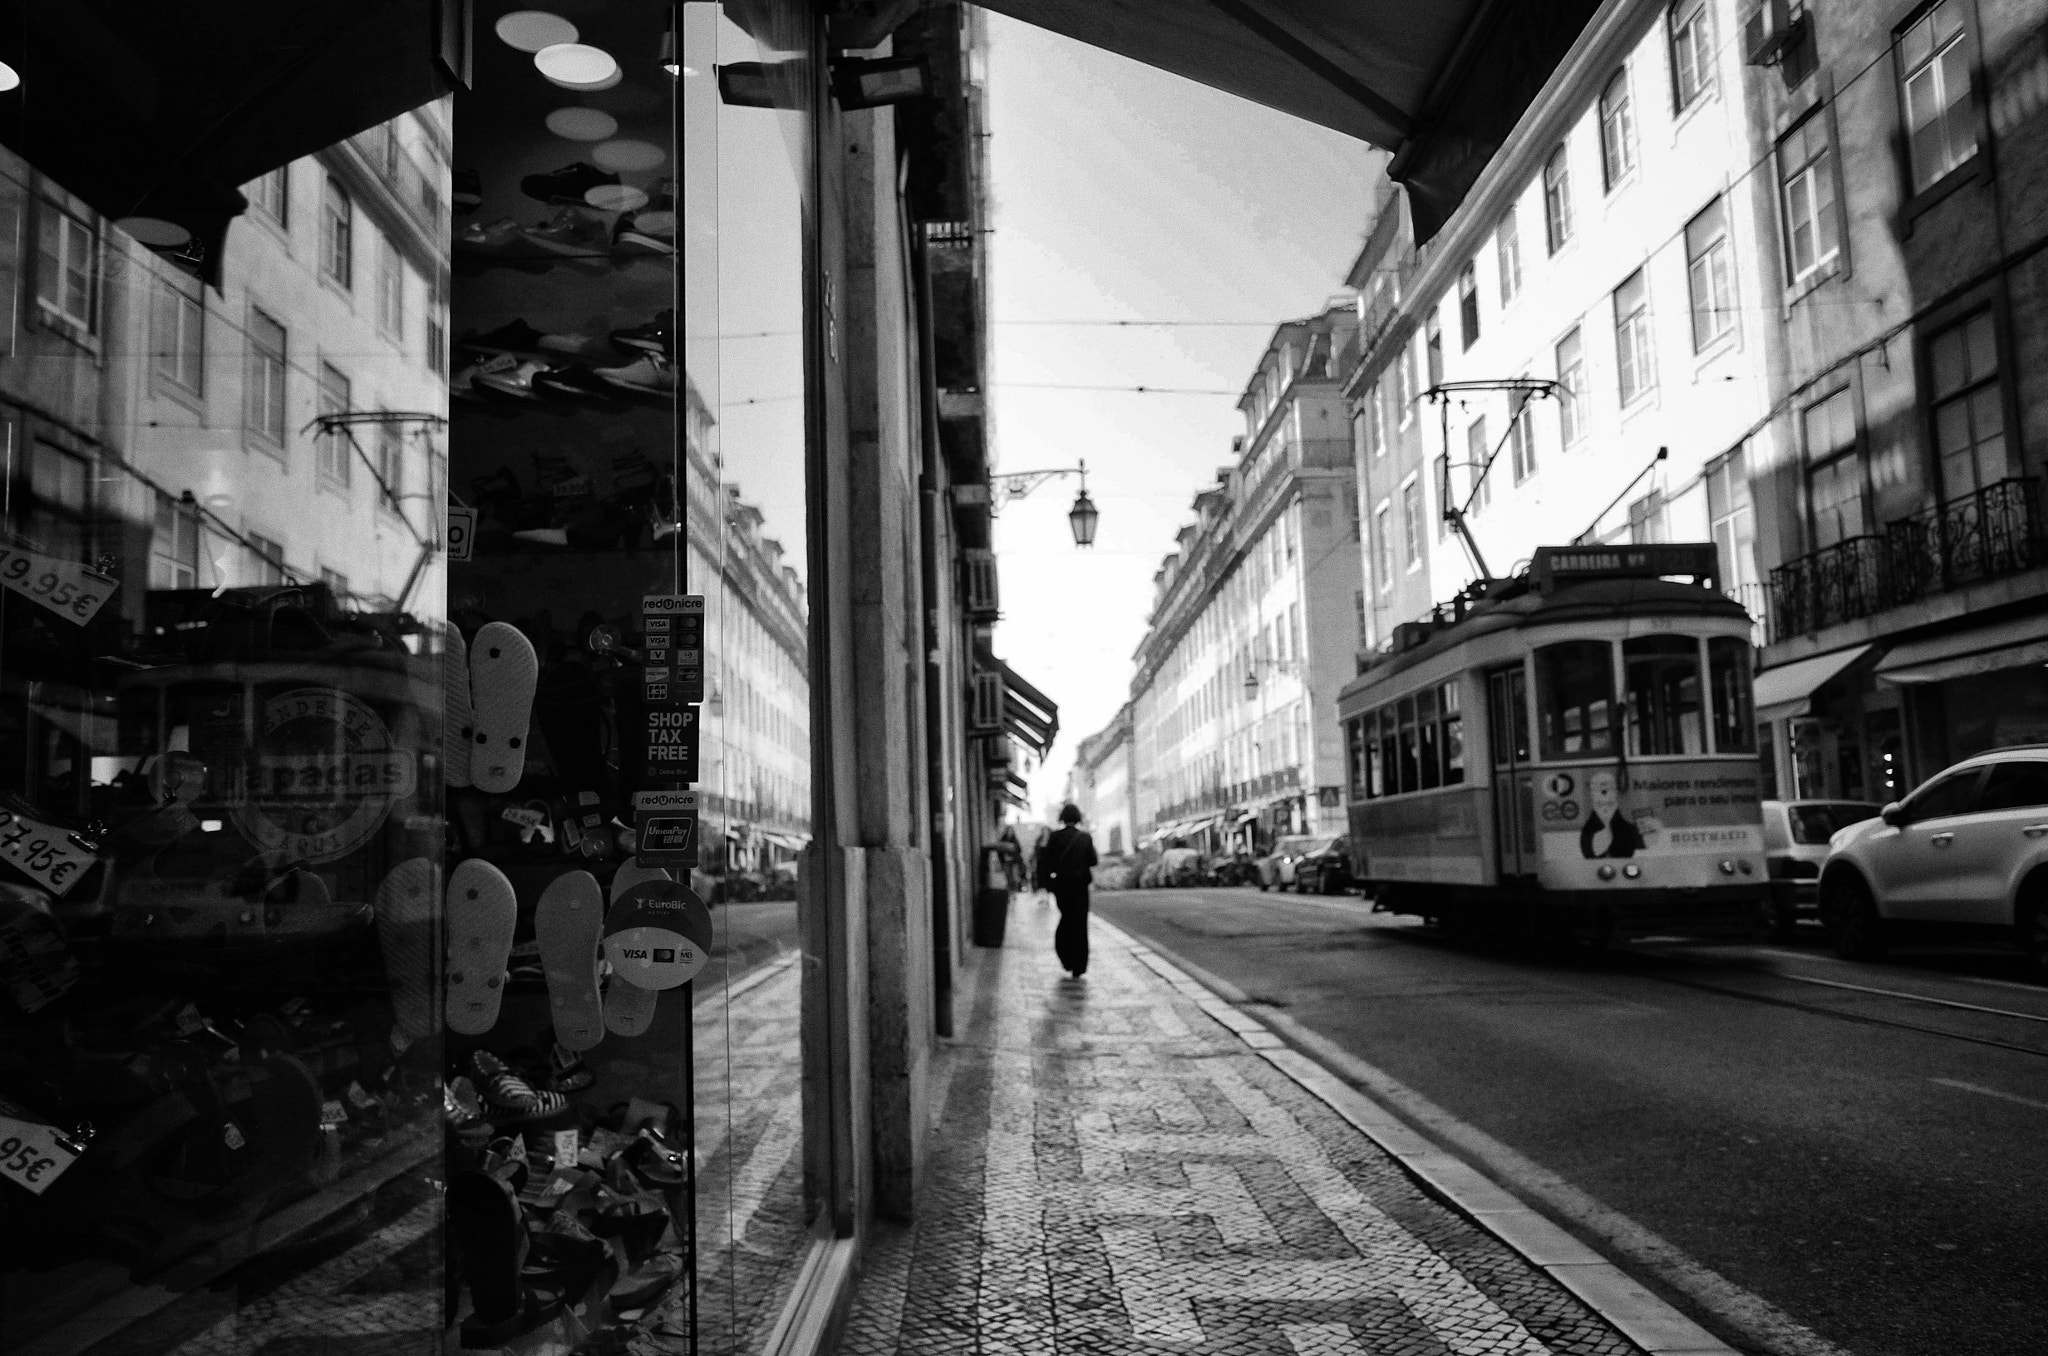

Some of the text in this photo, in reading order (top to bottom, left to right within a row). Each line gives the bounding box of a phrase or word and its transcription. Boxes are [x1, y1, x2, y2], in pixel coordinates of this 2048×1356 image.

[648, 711, 694, 728] SHOP
[648, 728, 682, 744] TAX
[648, 745, 689, 761] FREE
[648, 826, 688, 841] UnionPay
[648, 899, 687, 910] EuroBic
[623, 949, 648, 959] VISA
